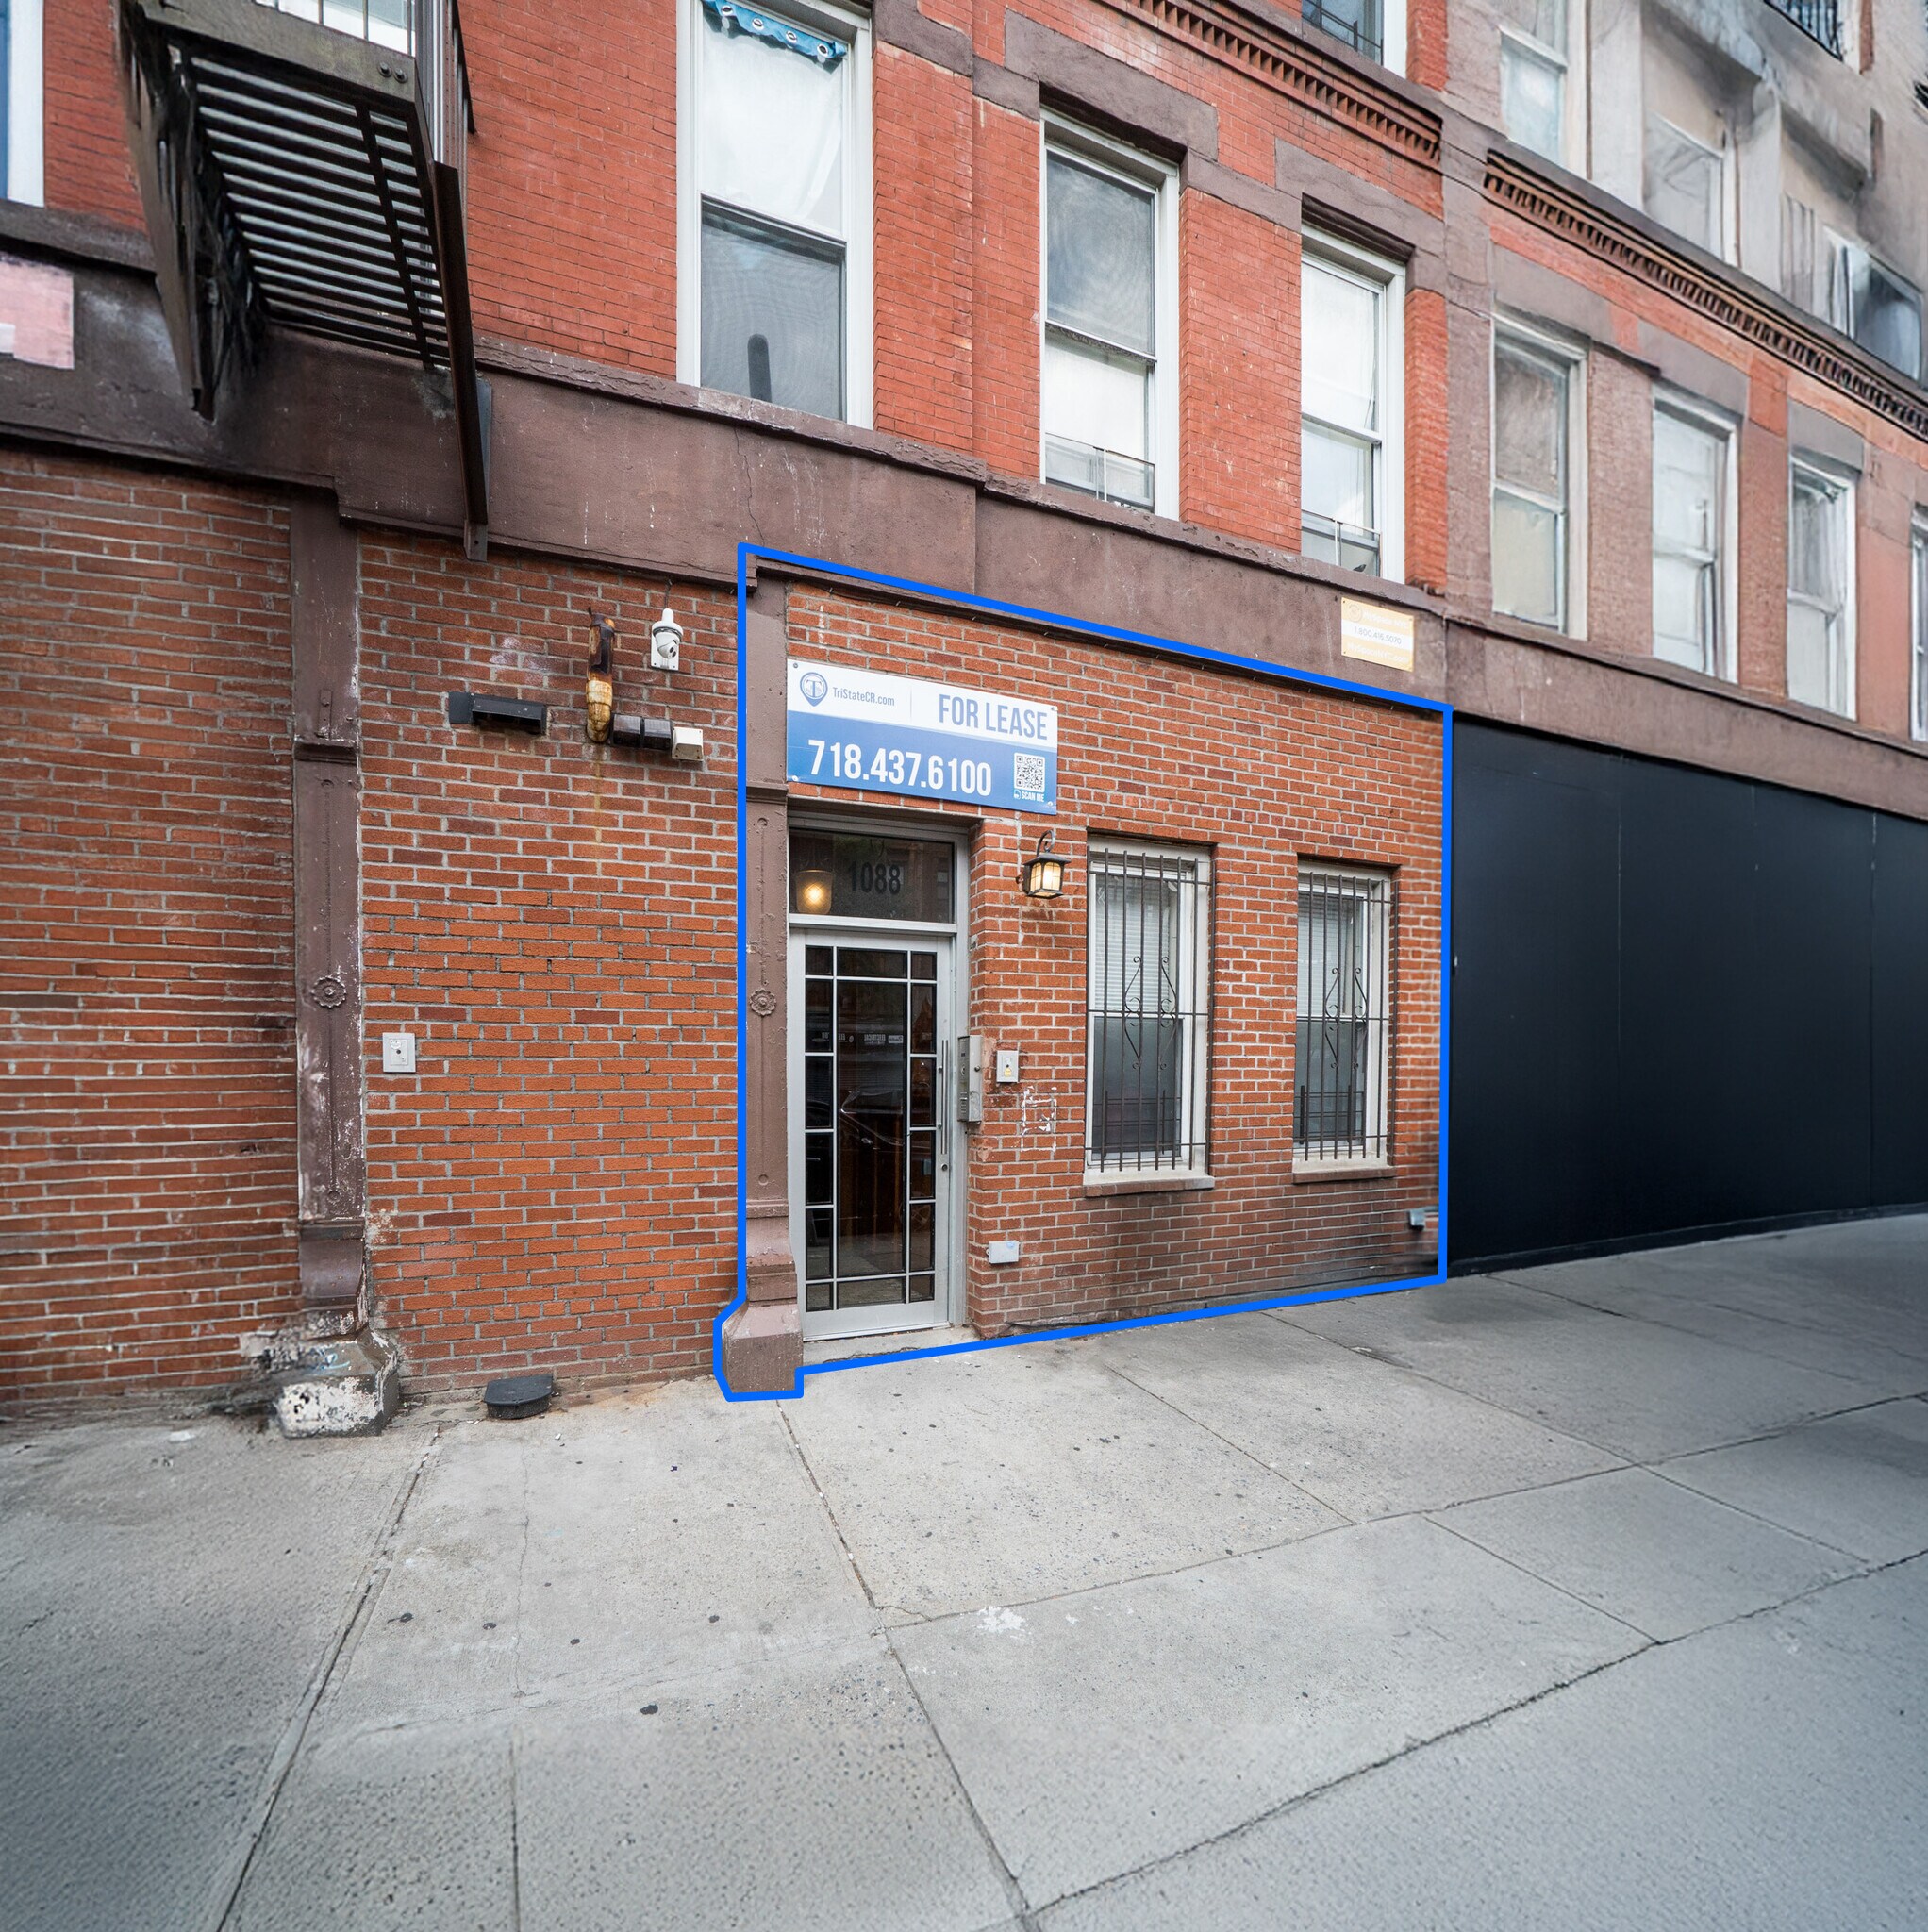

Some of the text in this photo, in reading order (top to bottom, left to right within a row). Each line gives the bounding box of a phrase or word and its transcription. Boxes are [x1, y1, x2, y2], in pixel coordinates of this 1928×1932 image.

[832, 687, 895, 707] TriStateCR.com
[939, 693, 1048, 741] FOR LEASE
[807, 739, 991, 797] 718.437.6100
[1022, 791, 1045, 803] SCAN ME
[852, 861, 901, 895] 1088
